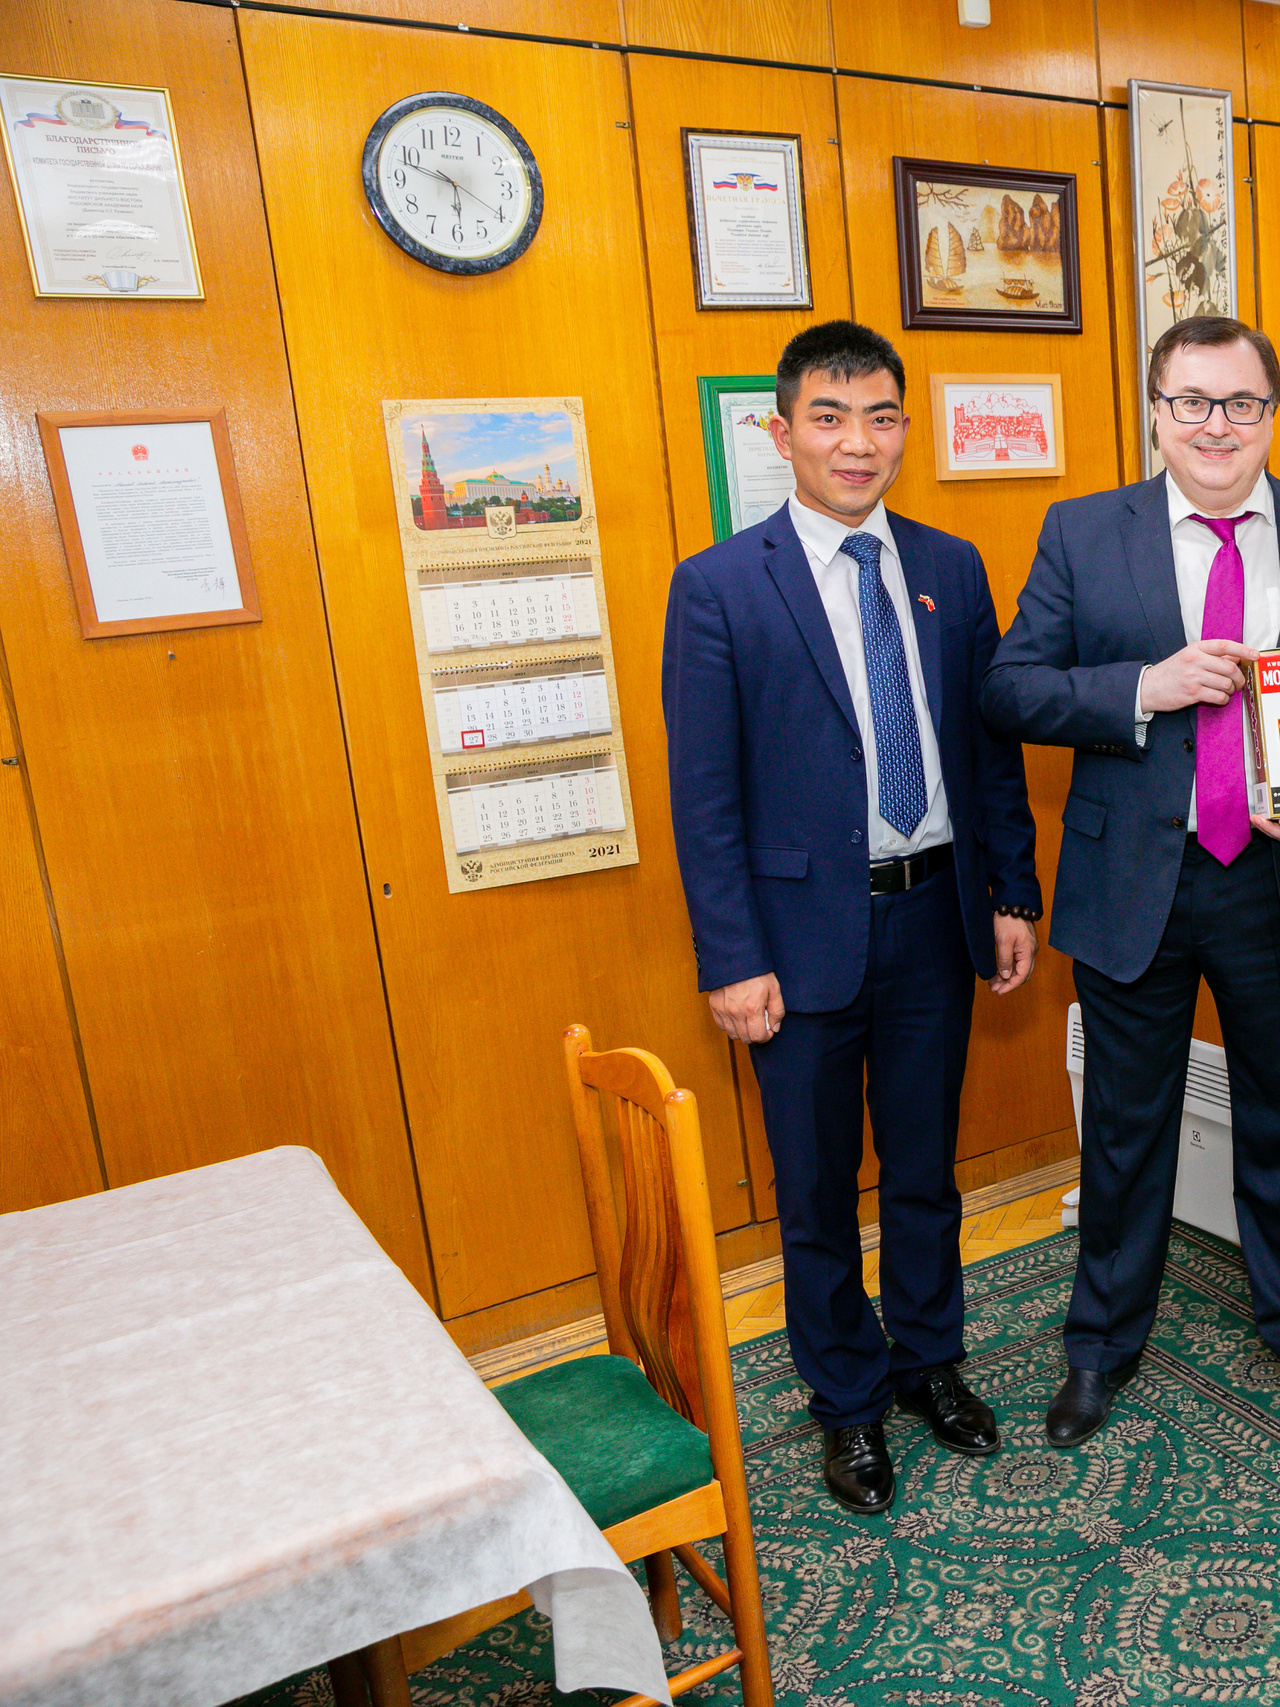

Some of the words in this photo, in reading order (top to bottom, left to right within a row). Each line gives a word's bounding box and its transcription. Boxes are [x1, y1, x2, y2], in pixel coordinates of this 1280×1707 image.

[421, 128, 434, 150] 11
[443, 125, 462, 148] 12
[476, 136, 481, 157] 1
[402, 145, 420, 168] 10
[492, 156, 505, 176] 2
[394, 168, 406, 189] 9
[501, 180, 513, 200] 3
[405, 194, 419, 214] 8
[493, 204, 506, 223] 4
[426, 214, 437, 235] 7
[452, 223, 464, 244] 6
[476, 219, 488, 239] 5
[561, 582, 565, 590] 1
[453, 602, 459, 610] 2
[472, 600, 478, 608] 3
[509, 597, 514, 605] 5
[544, 594, 549, 602] 7
[472, 611, 482, 619] 10
[490, 609, 499, 618] 11
[509, 608, 518, 616] 12
[527, 606, 536, 614] 13
[544, 605, 553, 613] 14
[562, 603, 571, 611] 15
[455, 624, 465, 632] 16
[474, 622, 482, 630] 17
[510, 619, 520, 627] 19
[527, 617, 537, 625] 20
[545, 616, 554, 624] 21
[562, 614, 572, 622] 22
[492, 631, 503, 640] 25
[511, 630, 521, 638] 26
[529, 628, 538, 636] 27
[564, 625, 574, 633] 29
[503, 688, 507, 696] 1
[520, 686, 525, 694] 2
[537, 684, 543, 692] 3
[572, 680, 578, 688] 5
[466, 703, 472, 711] 6
[485, 701, 490, 709] 7
[521, 697, 527, 705] 9
[538, 695, 547, 703] 10
[555, 693, 563, 701] 11
[573, 691, 581, 699] 12
[467, 714, 476, 722] 13
[485, 712, 494, 720] 14
[503, 710, 513, 718] 15
[521, 707, 531, 715] 16
[539, 705, 548, 713] 17
[574, 701, 583, 709] 19
[485, 723, 495, 731] 21
[504, 721, 514, 729] 22
[522, 718, 532, 727] 23
[540, 716, 549, 724] 24
[557, 714, 567, 722] 25
[574, 712, 584, 720] 26
[469, 736, 479, 744] 27
[487, 734, 498, 742] 28
[505, 731, 515, 739] 29
[523, 729, 533, 737] 30
[567, 779, 573, 787] 2
[534, 794, 539, 802] 7
[585, 787, 594, 795] 10
[480, 813, 489, 821] 11
[498, 810, 508, 818] 12
[516, 808, 526, 816] 13
[534, 805, 543, 813] 14
[552, 802, 561, 810] 15
[569, 800, 578, 808] 16
[586, 797, 595, 805] 17
[482, 824, 491, 832] 18
[500, 821, 509, 829] 19
[517, 818, 527, 826] 20
[535, 815, 544, 824] 21
[552, 813, 562, 821] 22
[569, 810, 580, 818] 23
[482, 834, 493, 842] 25
[500, 832, 511, 840] 26
[518, 828, 528, 837] 27
[536, 826, 547, 834] 28
[554, 823, 564, 831] 29
[588, 818, 598, 826] 31
[489, 857, 539, 868] АДМИНИСТРАЦИЯ
[540, 851, 576, 861] ПРЕЗИДЕНТА
[588, 844, 621, 859] 2021
[489, 864, 529, 874] РОССИЙСКОЙ
[529, 858, 564, 868] ФЕДЕРАЦИИ
